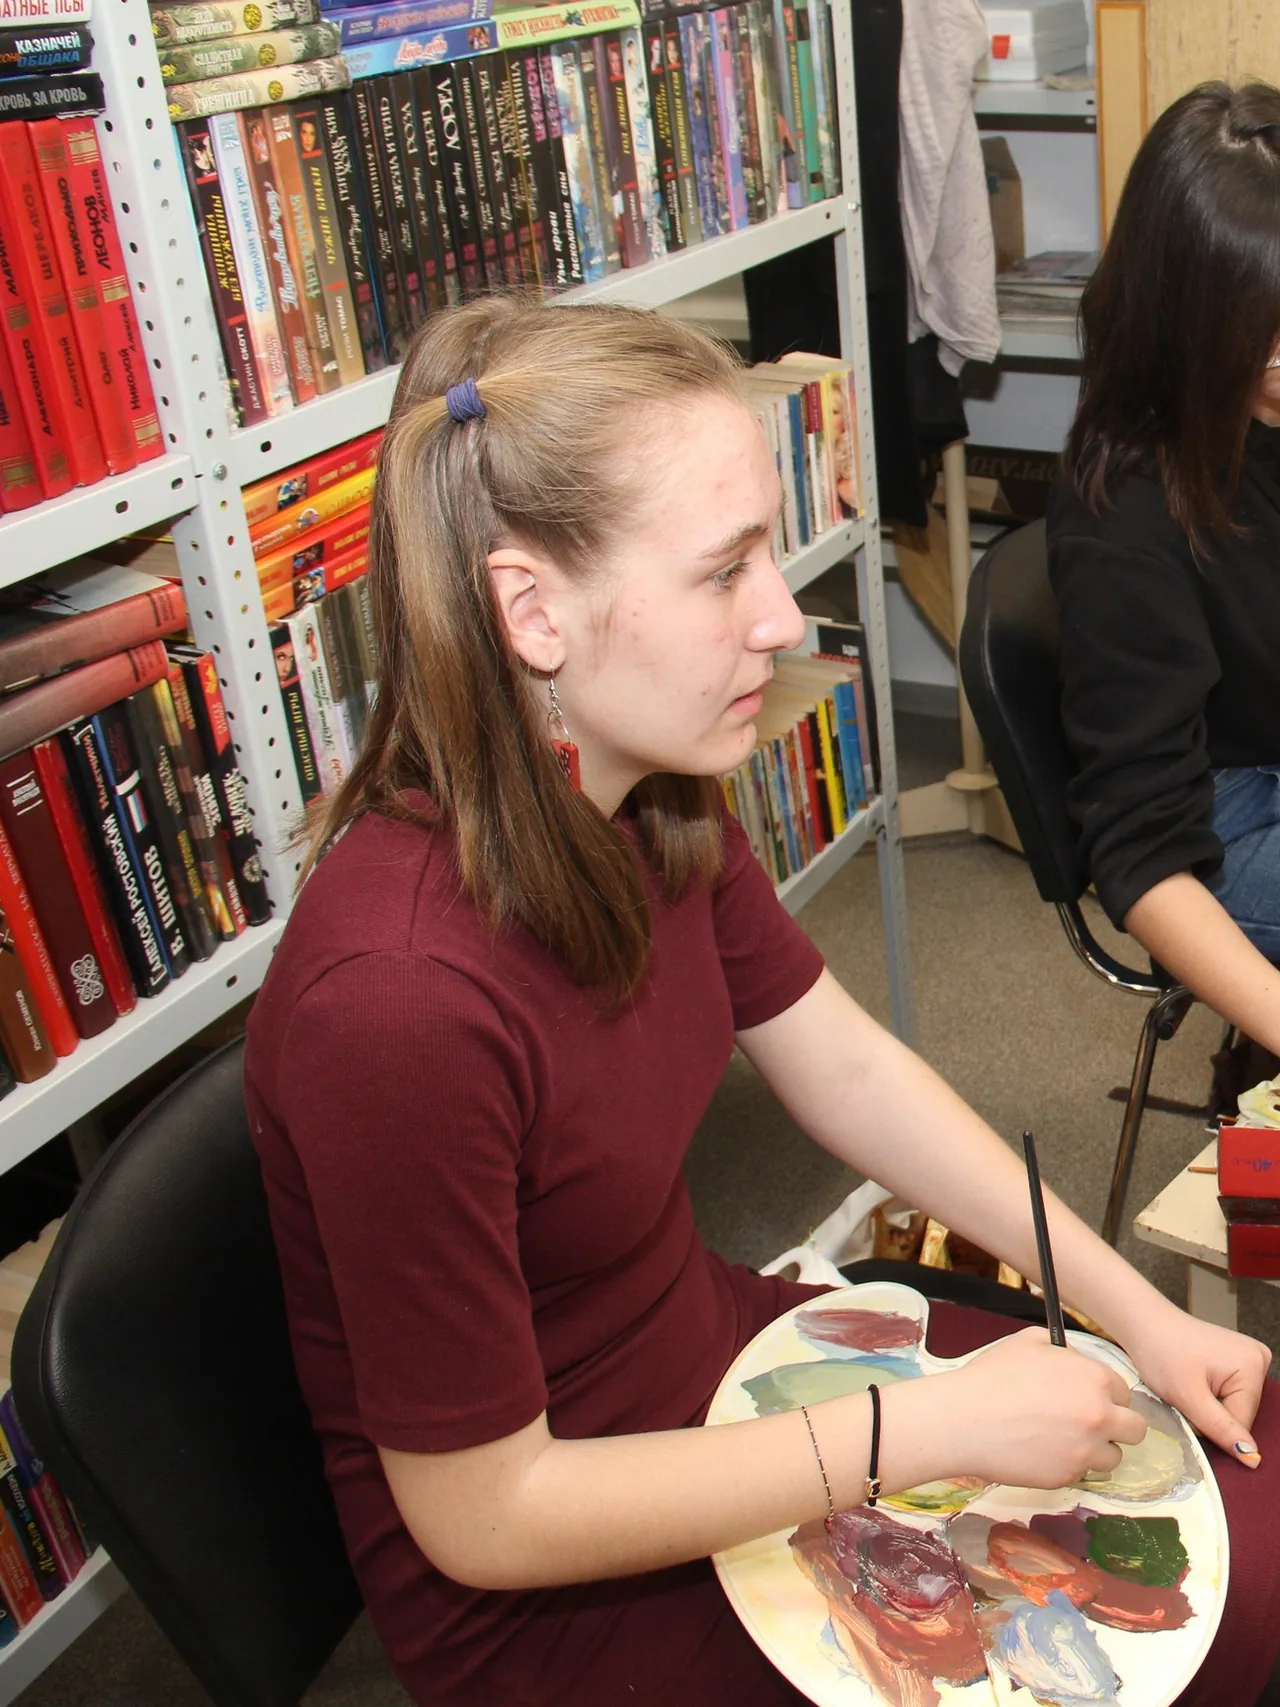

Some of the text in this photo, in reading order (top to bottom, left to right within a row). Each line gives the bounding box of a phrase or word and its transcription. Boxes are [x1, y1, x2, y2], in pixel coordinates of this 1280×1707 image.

[0, 0, 50, 18] АТНЫЕ
[15, 31, 82, 54] КАЗНАЧЕЙ
[17, 51, 81, 68] ОБЩАКА
[34, 90, 48, 106] ЗА
[49, 87, 87, 105] КРОВЬ
[436, 78, 461, 151] ЛОРЕЛ
[401, 102, 418, 154] РОЗА
[310, 166, 329, 212] БРАКИ
[57, 176, 88, 277] ПРИХОДЬКО
[84, 194, 111, 270] ЛЕОНОВ
[211, 195, 237, 275] МУЖЧИНЫ
[549, 211, 568, 284] Узы крови
[559, 171, 583, 278] Расколотые сны
[205, 213, 230, 289] ЖЕНЩИНА
[335, 295, 351, 334] ТОМАС
[235, 326, 250, 360] СКОТТ
[288, 692, 303, 726] ИГРЫ
[102, 813, 165, 972] АЛЕКСЕЙ РОСТОВСКИЙ
[143, 845, 186, 957] В. ШИТОВ
[15, 990, 34, 1027] СЕМЕНОВ
